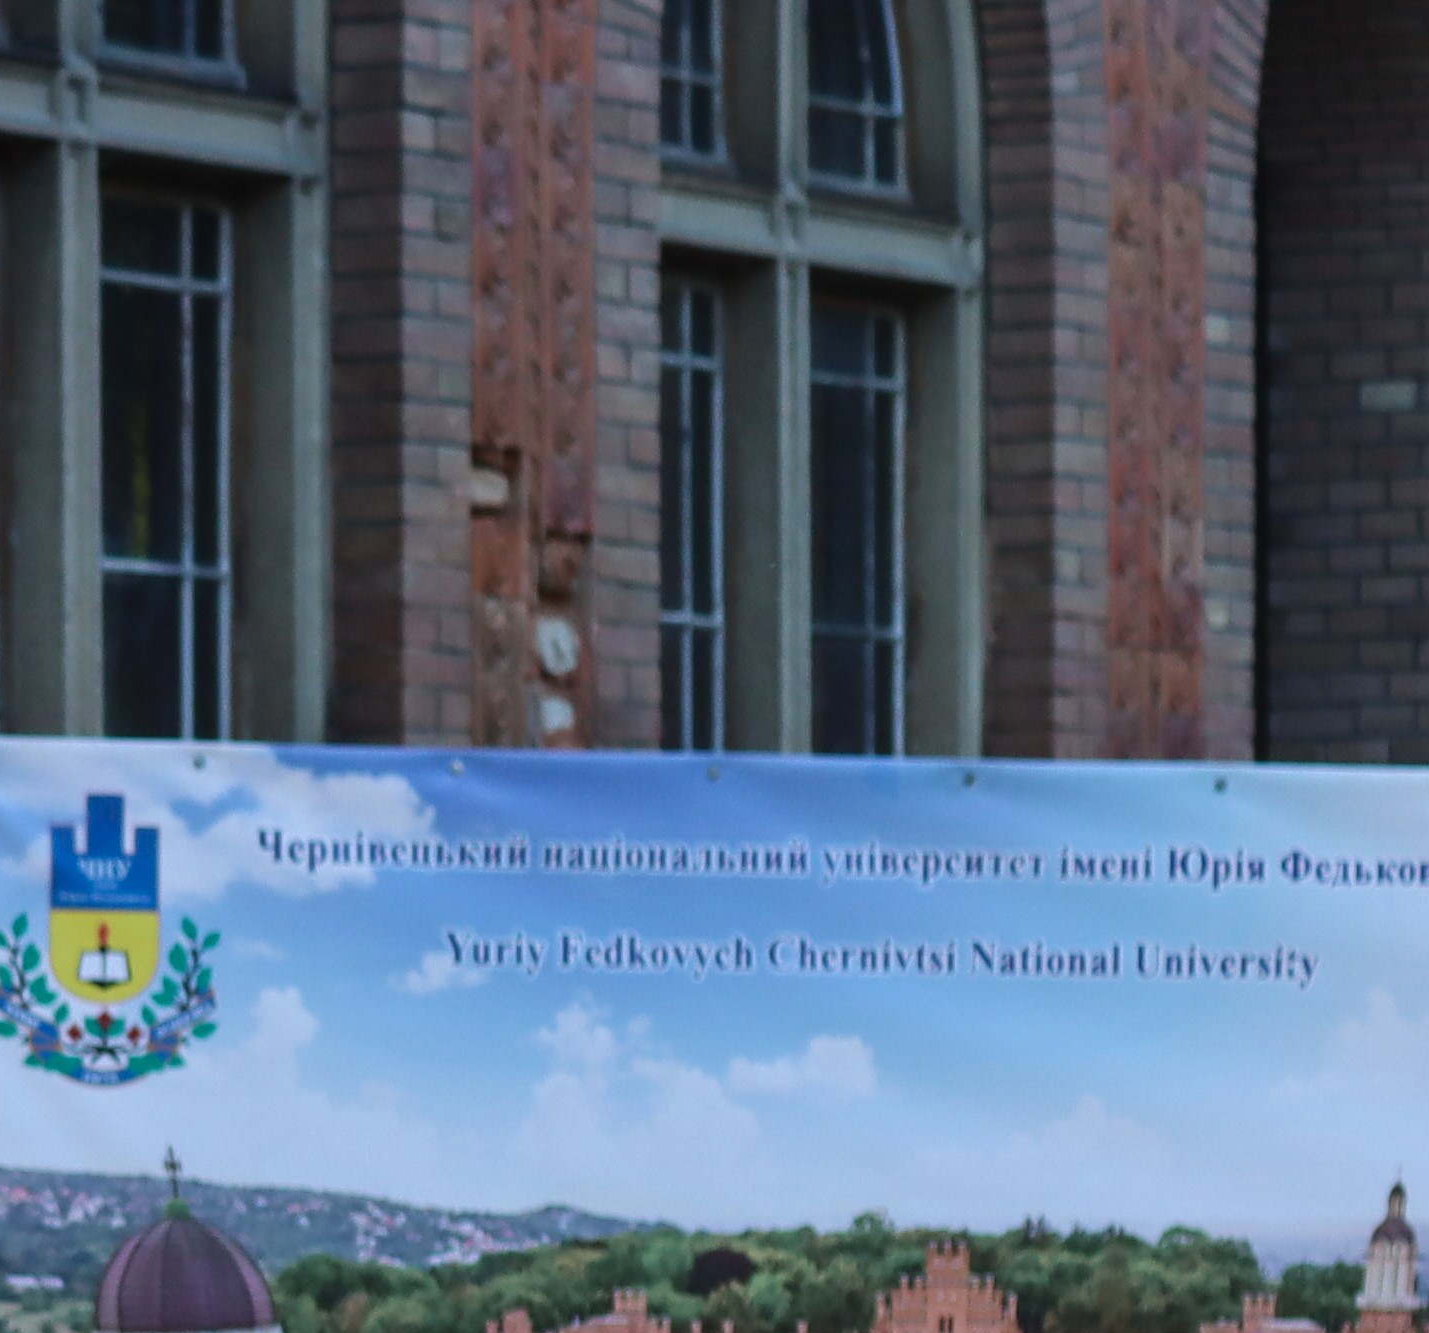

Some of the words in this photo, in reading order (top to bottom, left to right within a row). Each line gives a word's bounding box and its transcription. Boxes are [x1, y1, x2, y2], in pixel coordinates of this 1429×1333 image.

[257, 828, 529, 874] Чернівецький
[543, 833, 811, 876] національний
[823, 841, 1045, 889] університет
[1059, 842, 1154, 881] імені
[1167, 847, 1266, 892] Юрія
[446, 931, 541, 978] Yuriy
[559, 931, 753, 979] Fedkovych
[767, 937, 957, 976] Chernivtsi
[970, 941, 1121, 978] National
[1136, 944, 1319, 987] University
